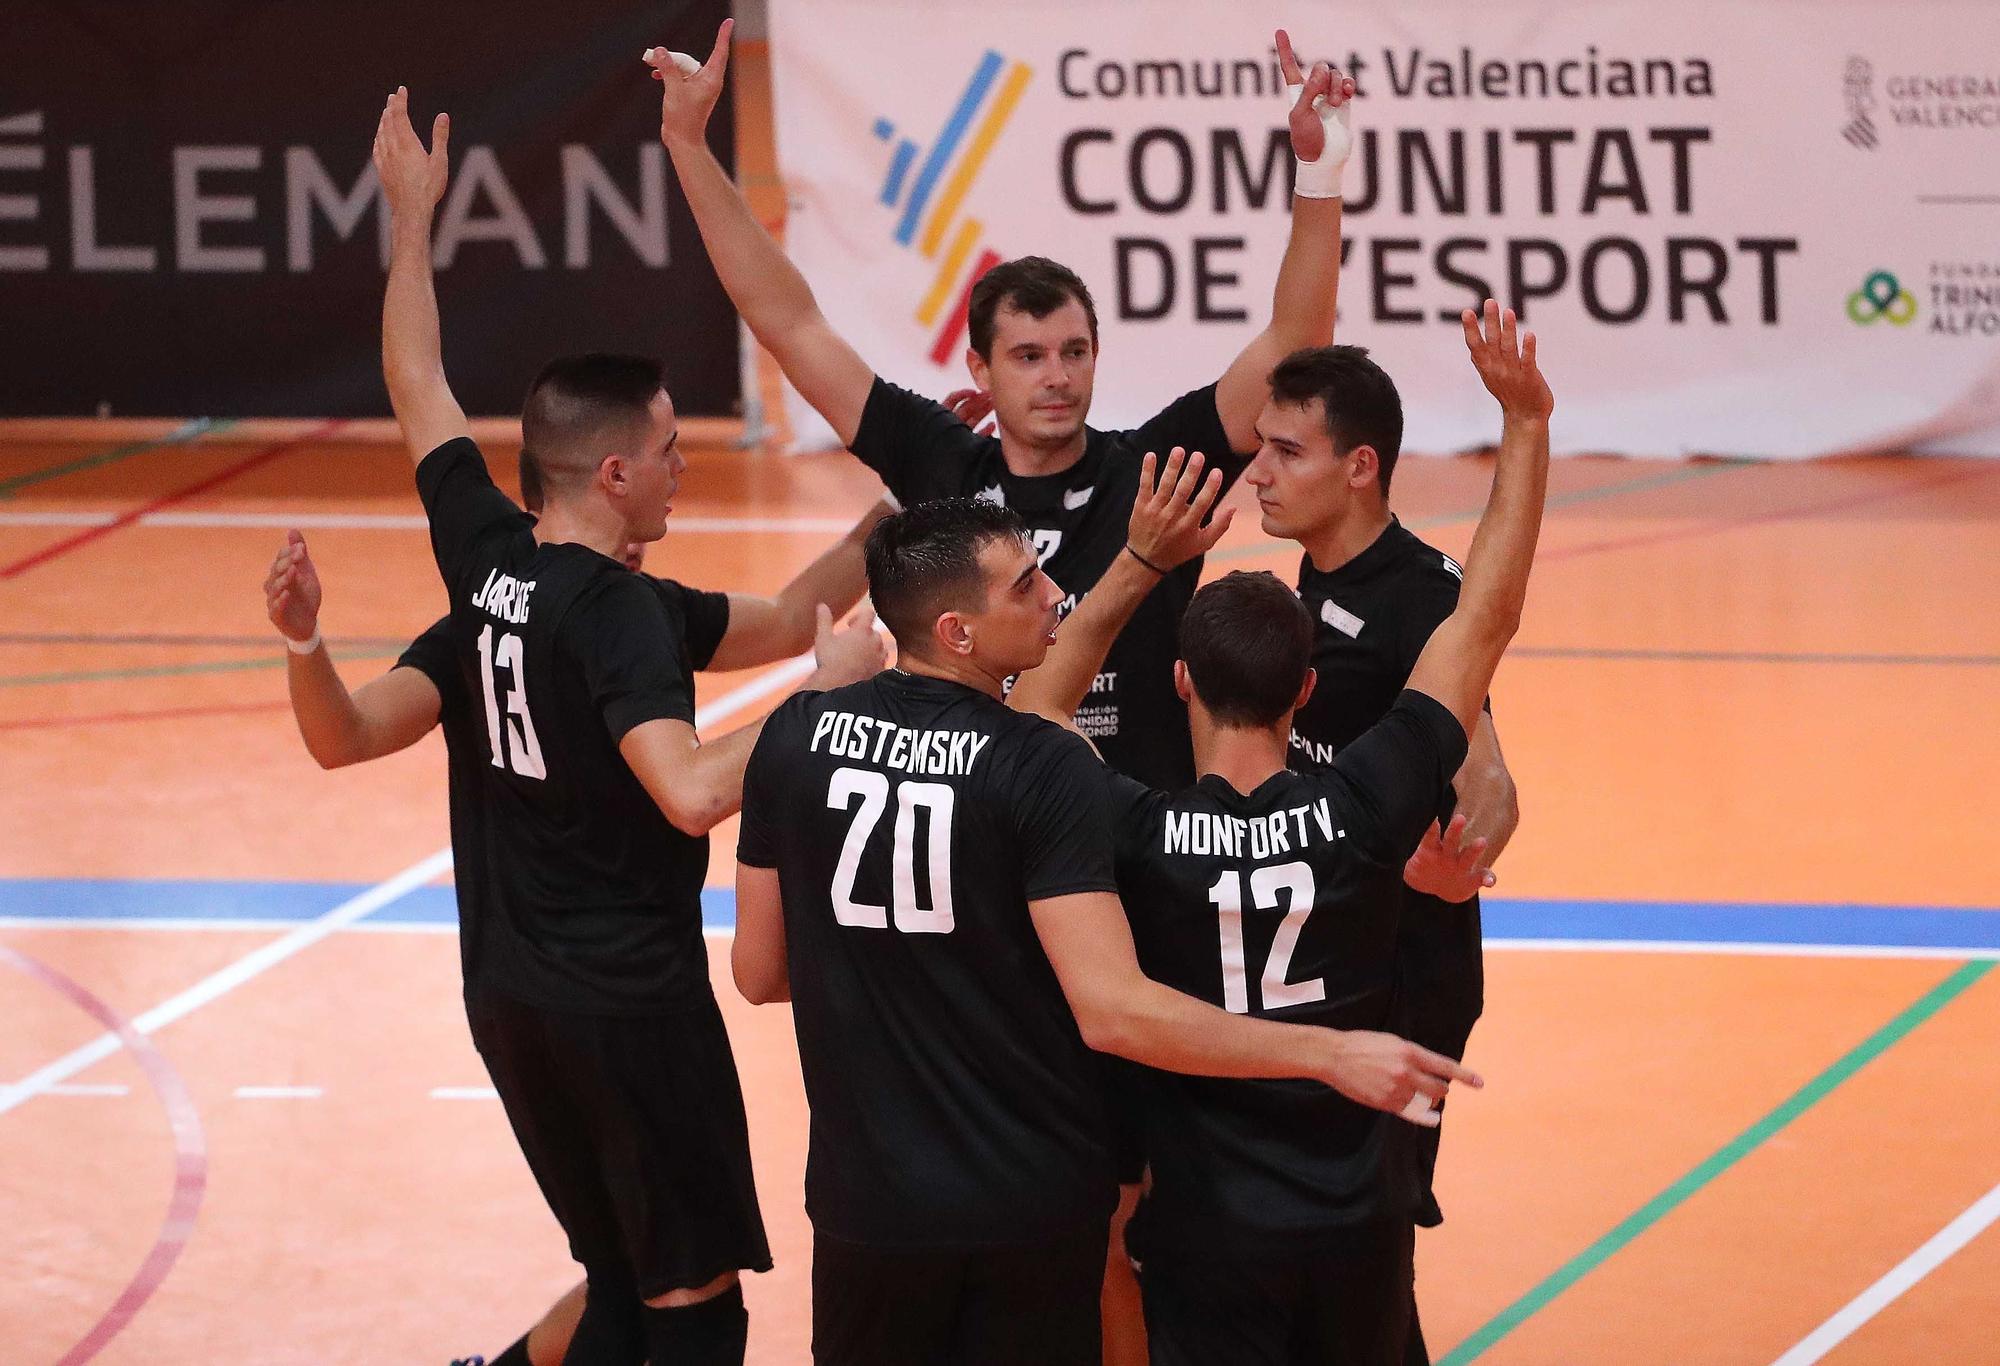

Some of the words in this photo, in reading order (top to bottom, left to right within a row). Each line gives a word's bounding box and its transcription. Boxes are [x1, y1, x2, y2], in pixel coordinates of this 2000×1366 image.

[1383, 45, 1714, 98] Valenciana
[1886, 75, 2000, 99] GENERA
[1113, 236, 1248, 322] DE
[477, 622, 547, 781] 13
[810, 711, 990, 776] POSTEMSKY
[826, 766, 955, 934] 20
[1208, 860, 1326, 1014] 12
